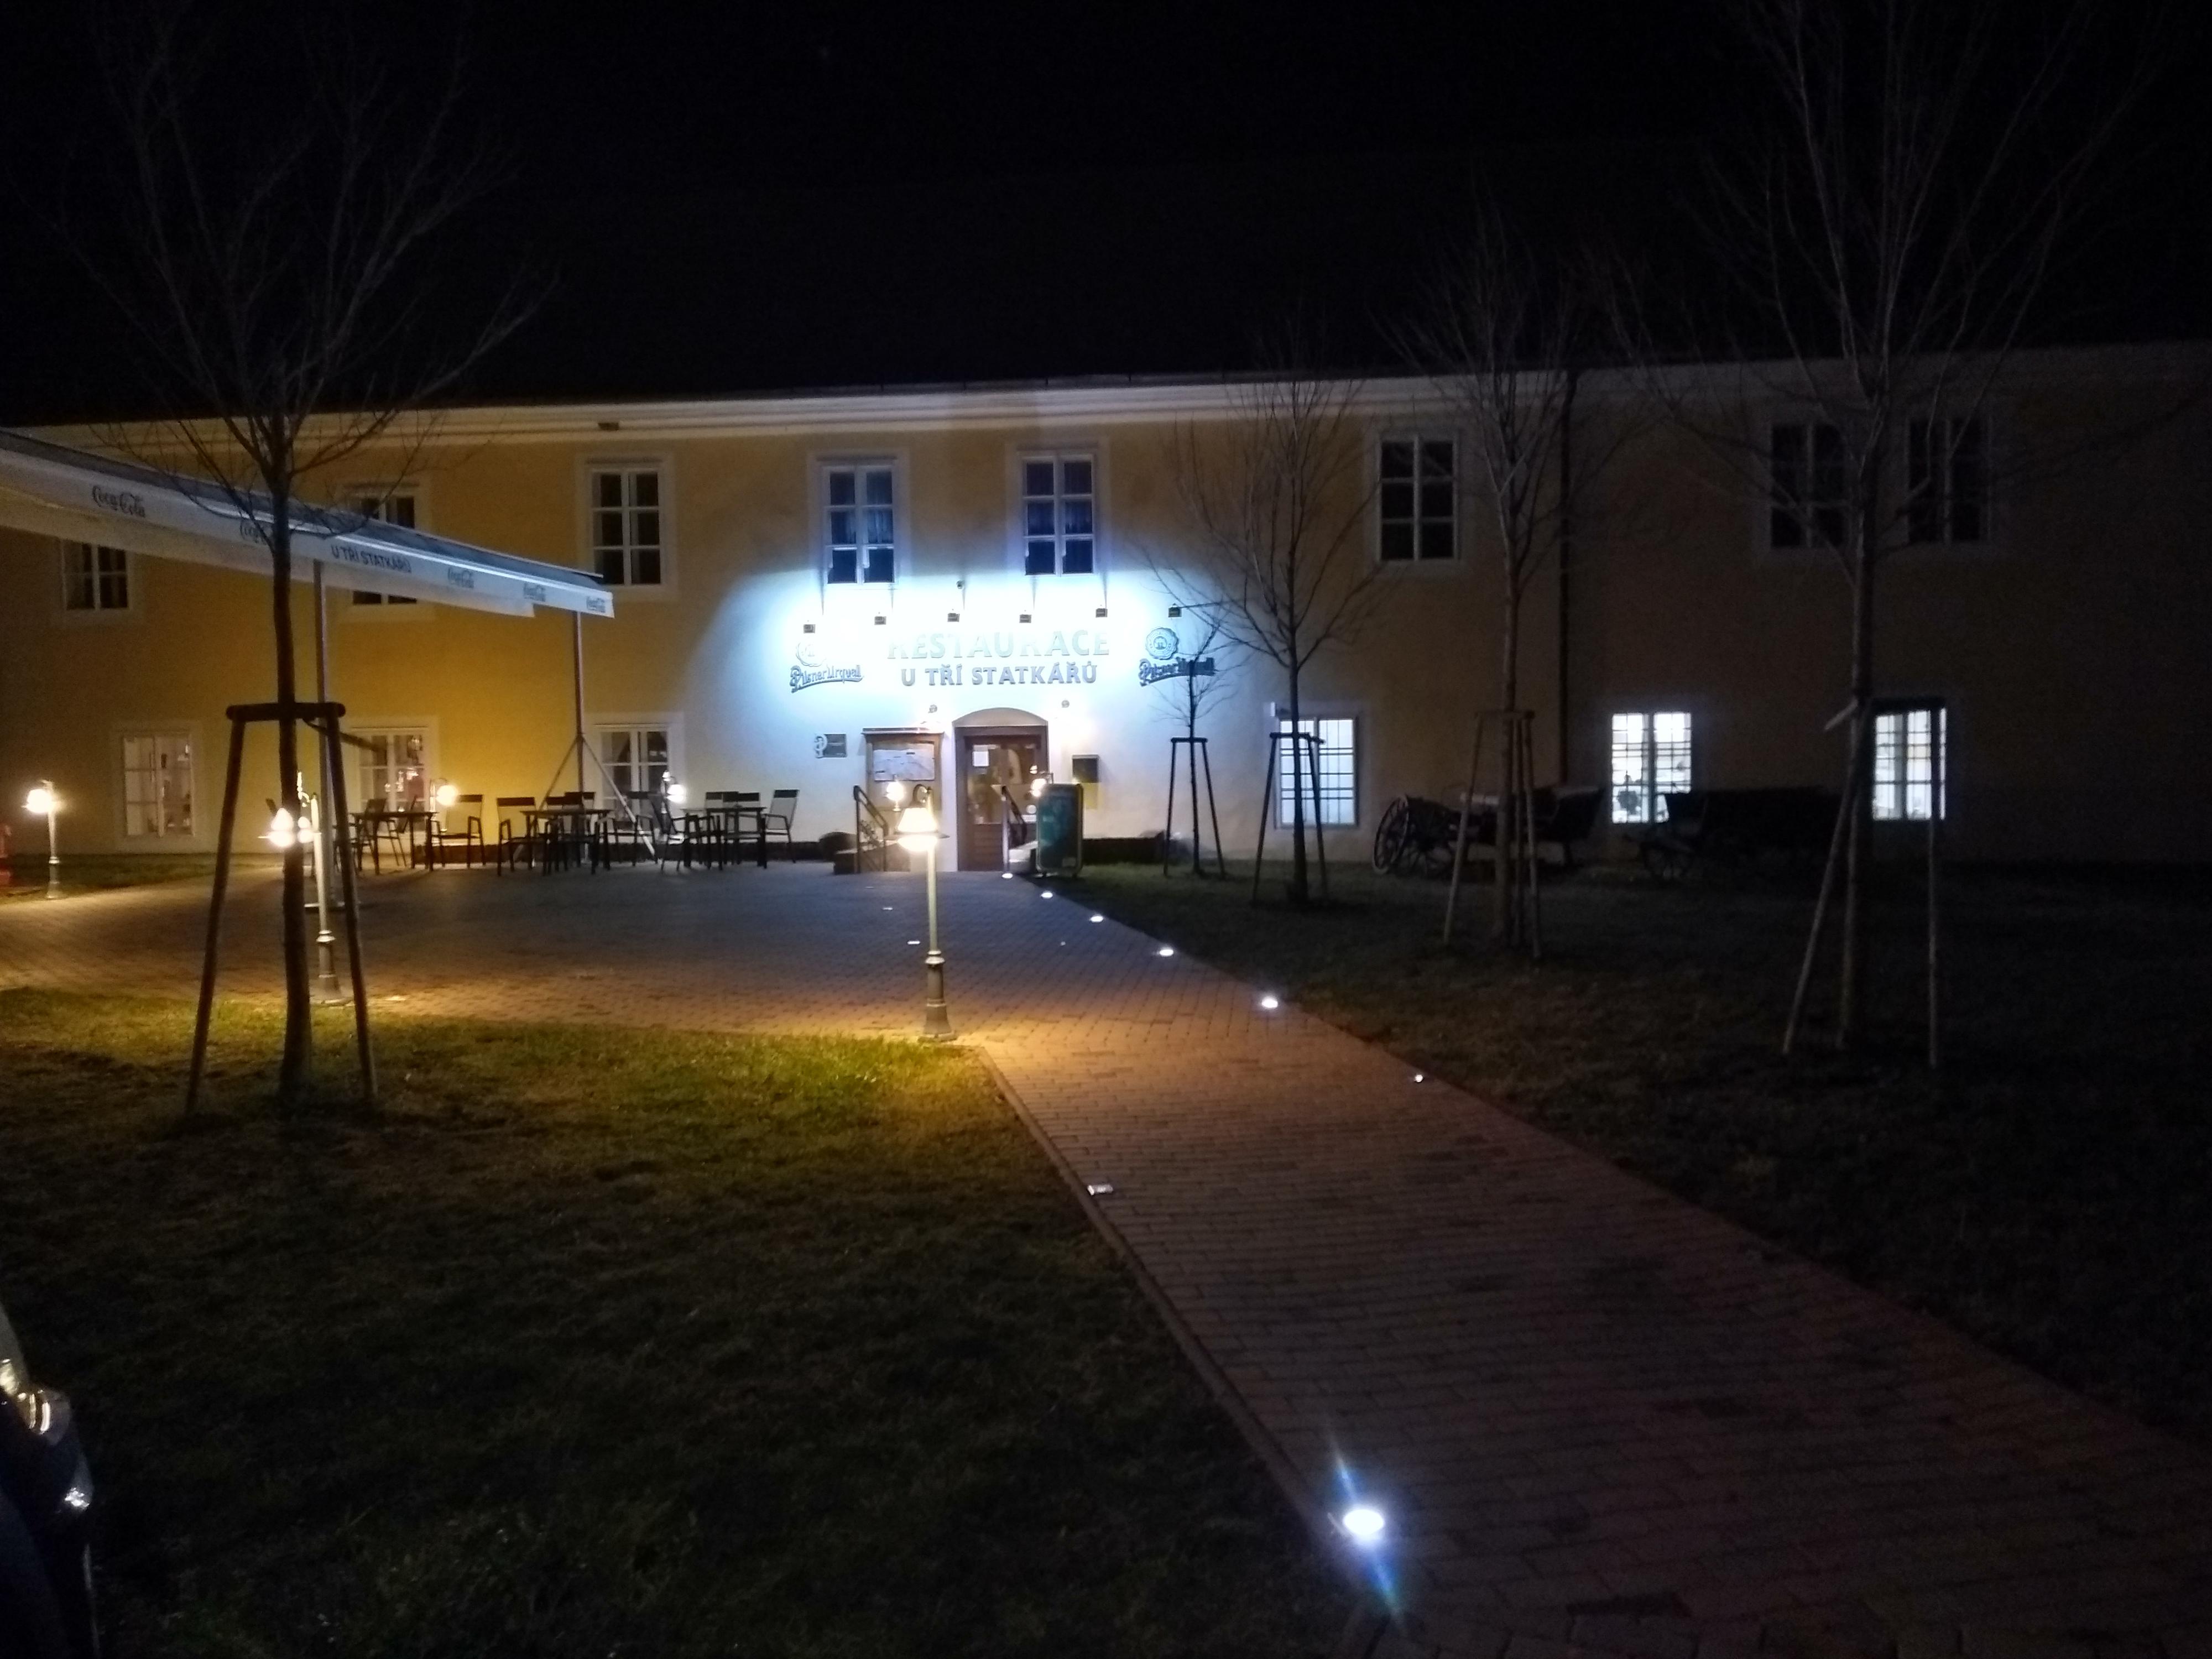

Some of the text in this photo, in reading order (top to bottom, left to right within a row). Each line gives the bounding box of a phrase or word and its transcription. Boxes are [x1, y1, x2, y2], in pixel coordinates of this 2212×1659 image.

[886, 629, 1110, 660] RESTAURACE
[789, 665, 827, 691] Pilsner
[901, 661, 1098, 687] U TŘÍ STATKÁŘŮ
